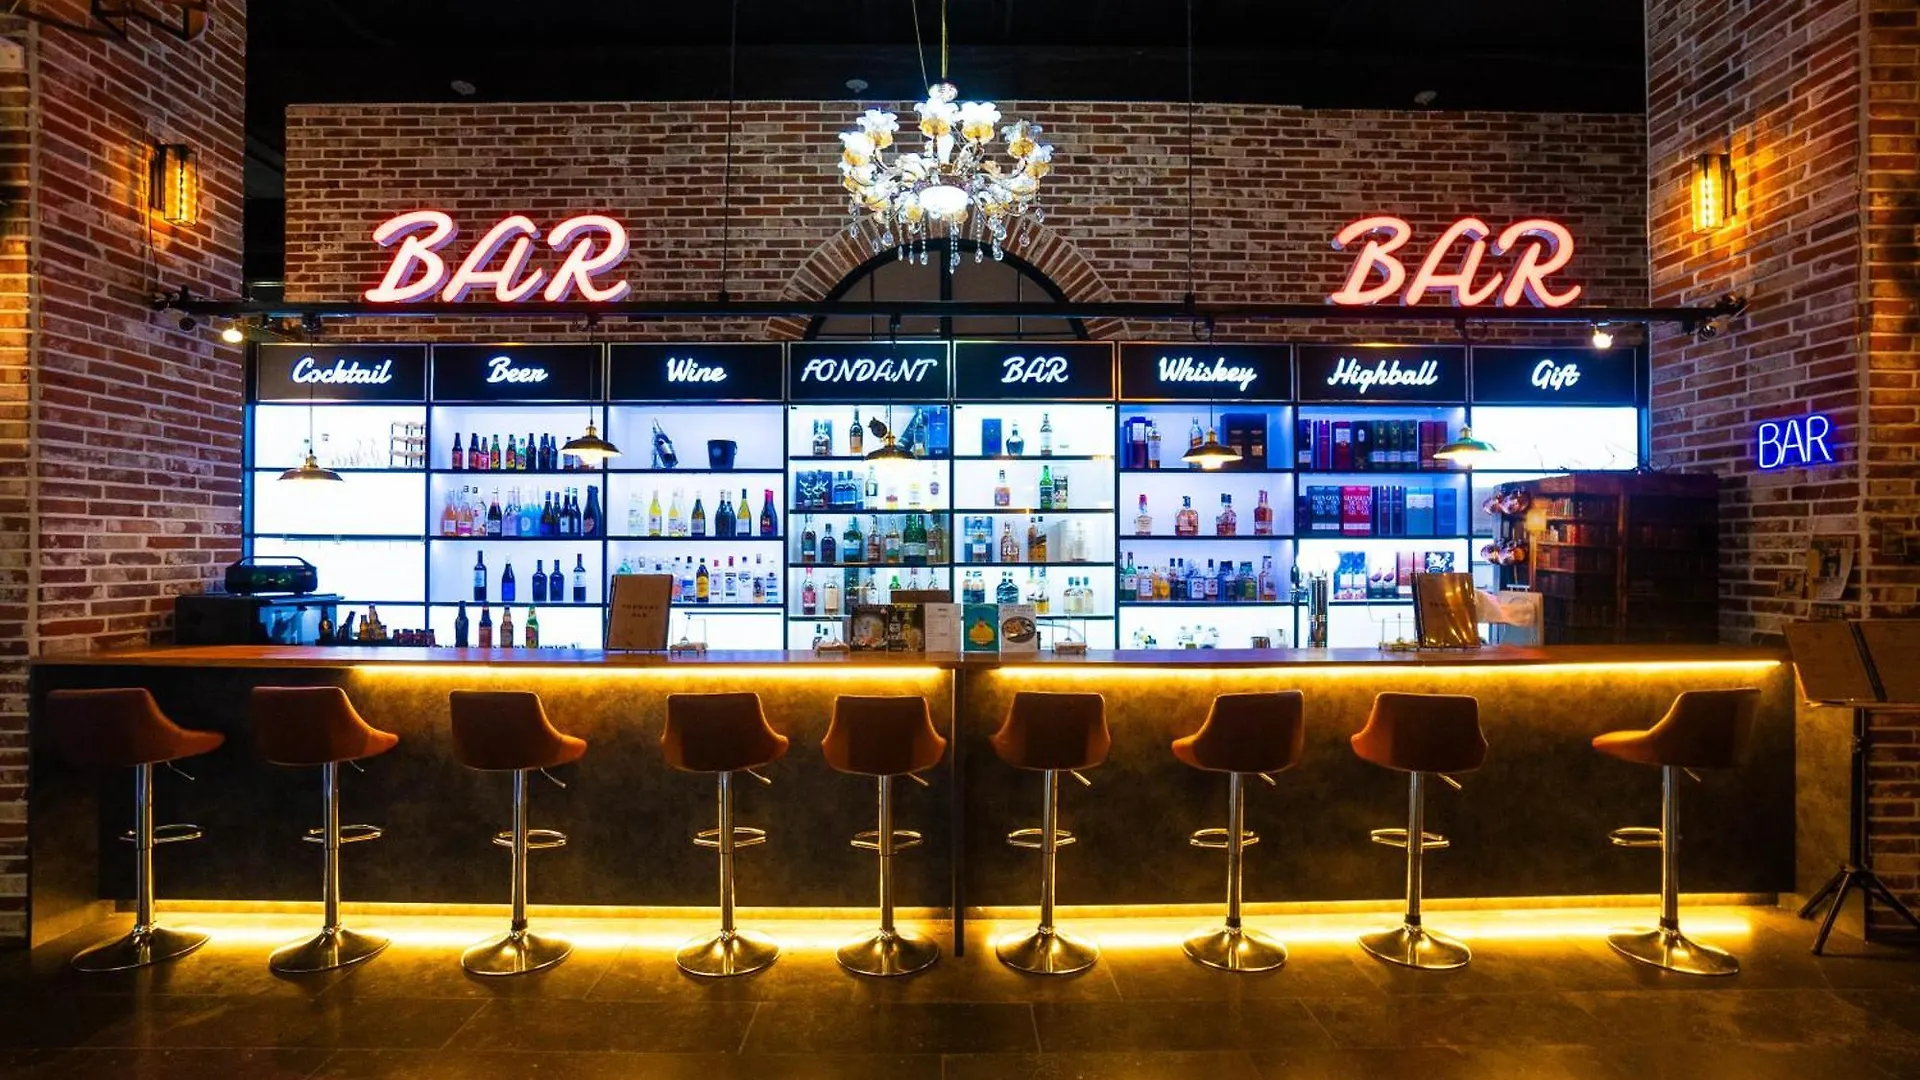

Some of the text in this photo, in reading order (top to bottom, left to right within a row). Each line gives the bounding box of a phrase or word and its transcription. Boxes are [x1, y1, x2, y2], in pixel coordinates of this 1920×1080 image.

[364, 210, 631, 303] BAR
[1327, 215, 1583, 307] BAR
[292, 357, 392, 384] Cocktail
[487, 356, 549, 383] Beer
[667, 357, 728, 382] Wine
[801, 358, 938, 382] FONDANT
[1002, 356, 1068, 383] BAR
[1159, 357, 1257, 391] Whiskey
[1327, 358, 1438, 393] Highball
[1531, 359, 1581, 391] Gift
[1758, 415, 1833, 469] BAR
